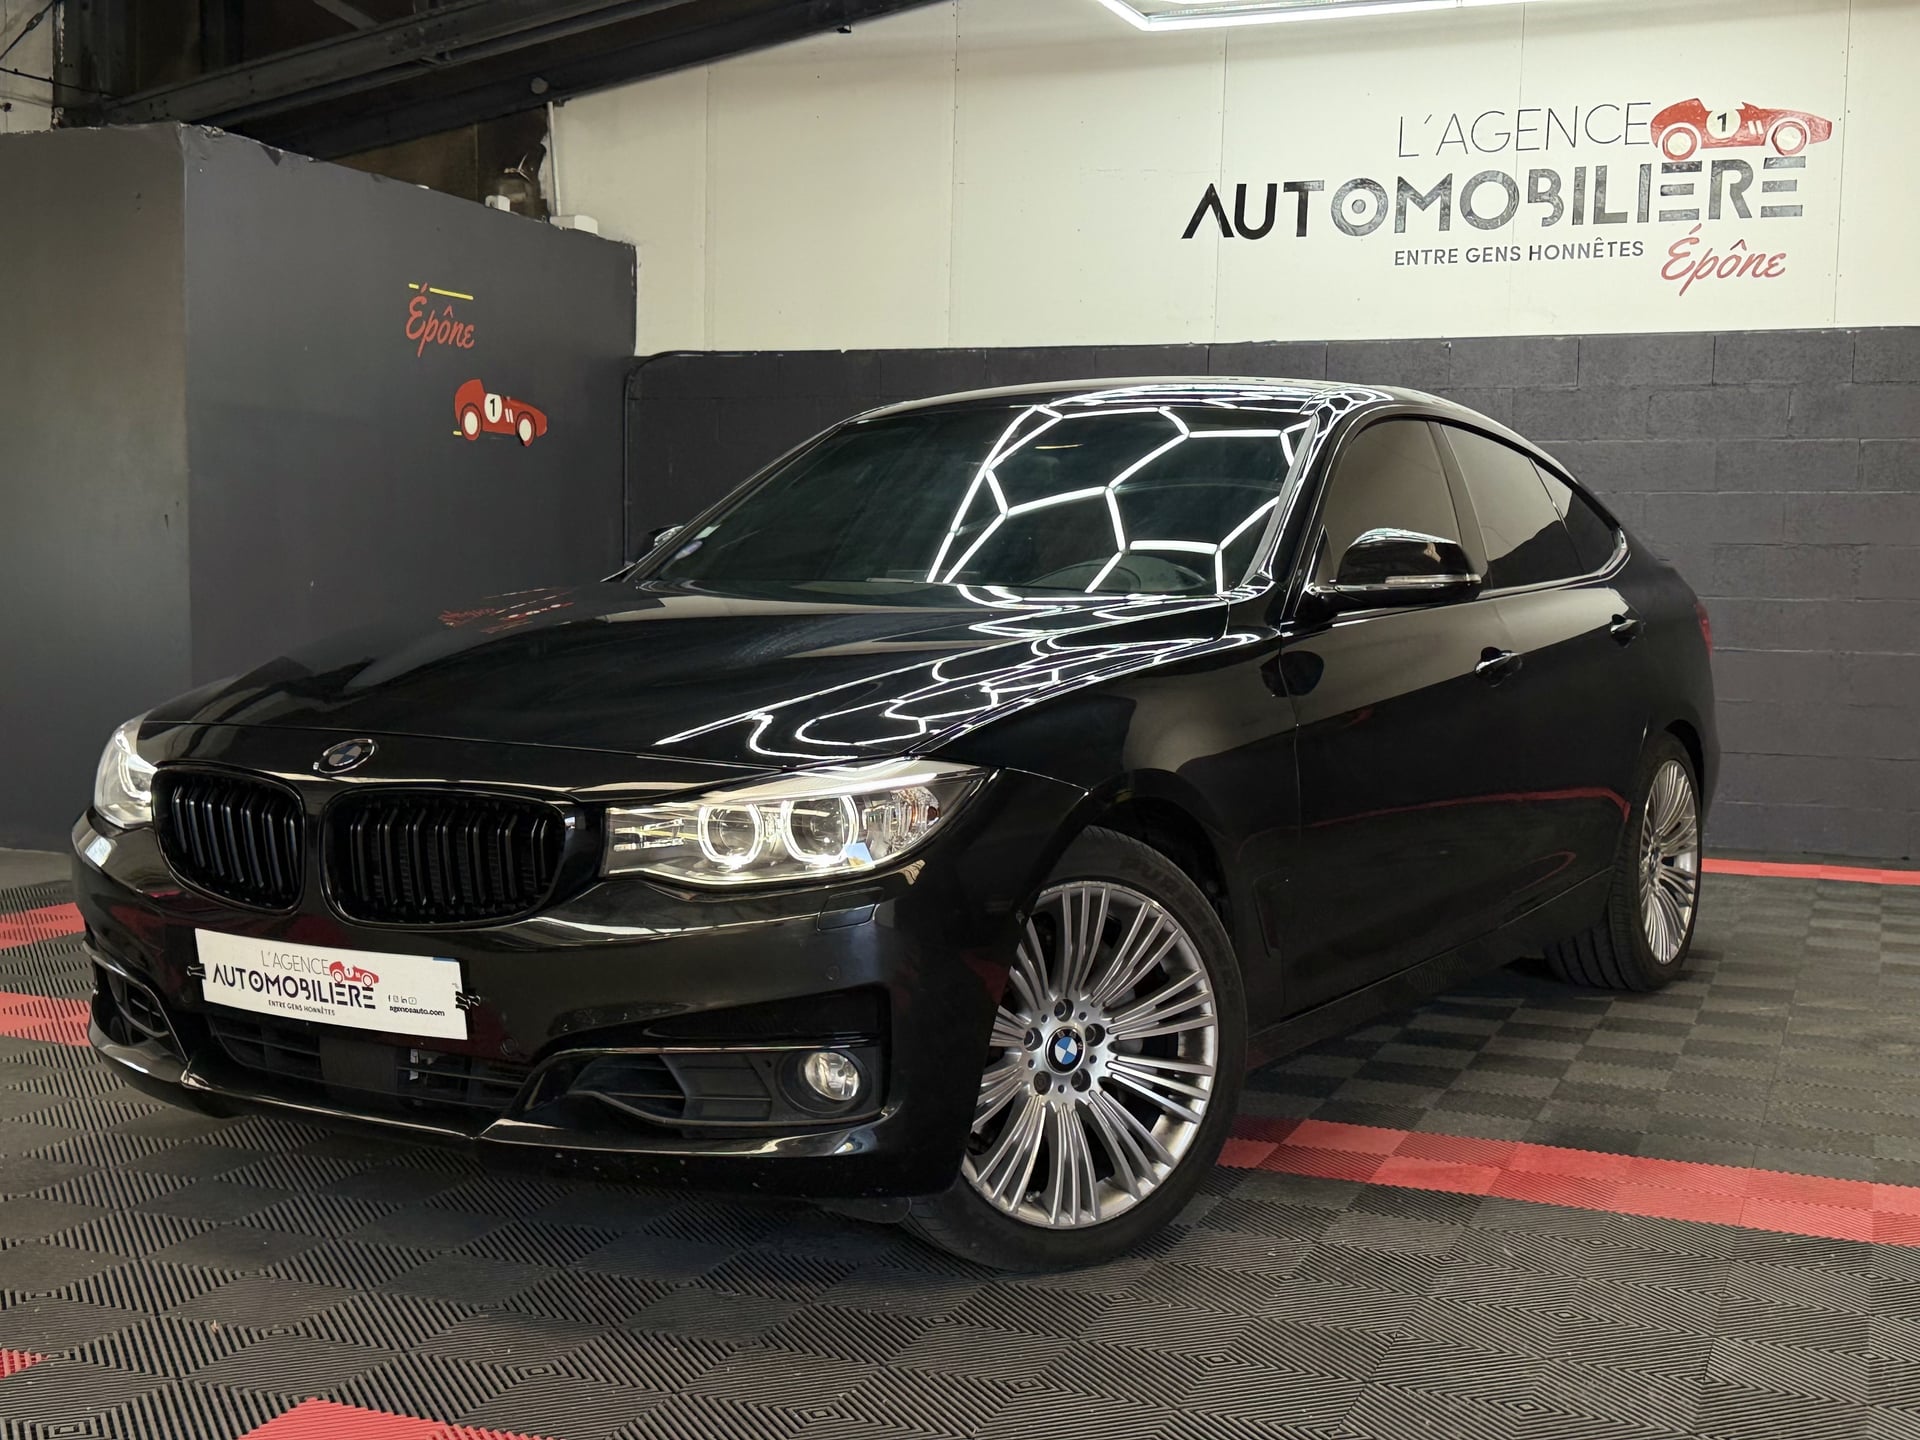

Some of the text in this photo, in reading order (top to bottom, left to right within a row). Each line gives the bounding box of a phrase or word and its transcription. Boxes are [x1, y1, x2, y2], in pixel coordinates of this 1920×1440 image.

[1398, 102, 1652, 158] L'AGENCE
[1716, 112, 1728, 133] 1
[1393, 236, 1645, 266] ENTRE GENS HONNÊTES
[1660, 222, 1787, 297] Épône
[405, 282, 476, 358] Épône
[489, 397, 496, 417] 1
[260, 949, 331, 977] L'AGENCE
[267, 999, 287, 1010] ENTRE
[287, 1002, 303, 1012] GENS
